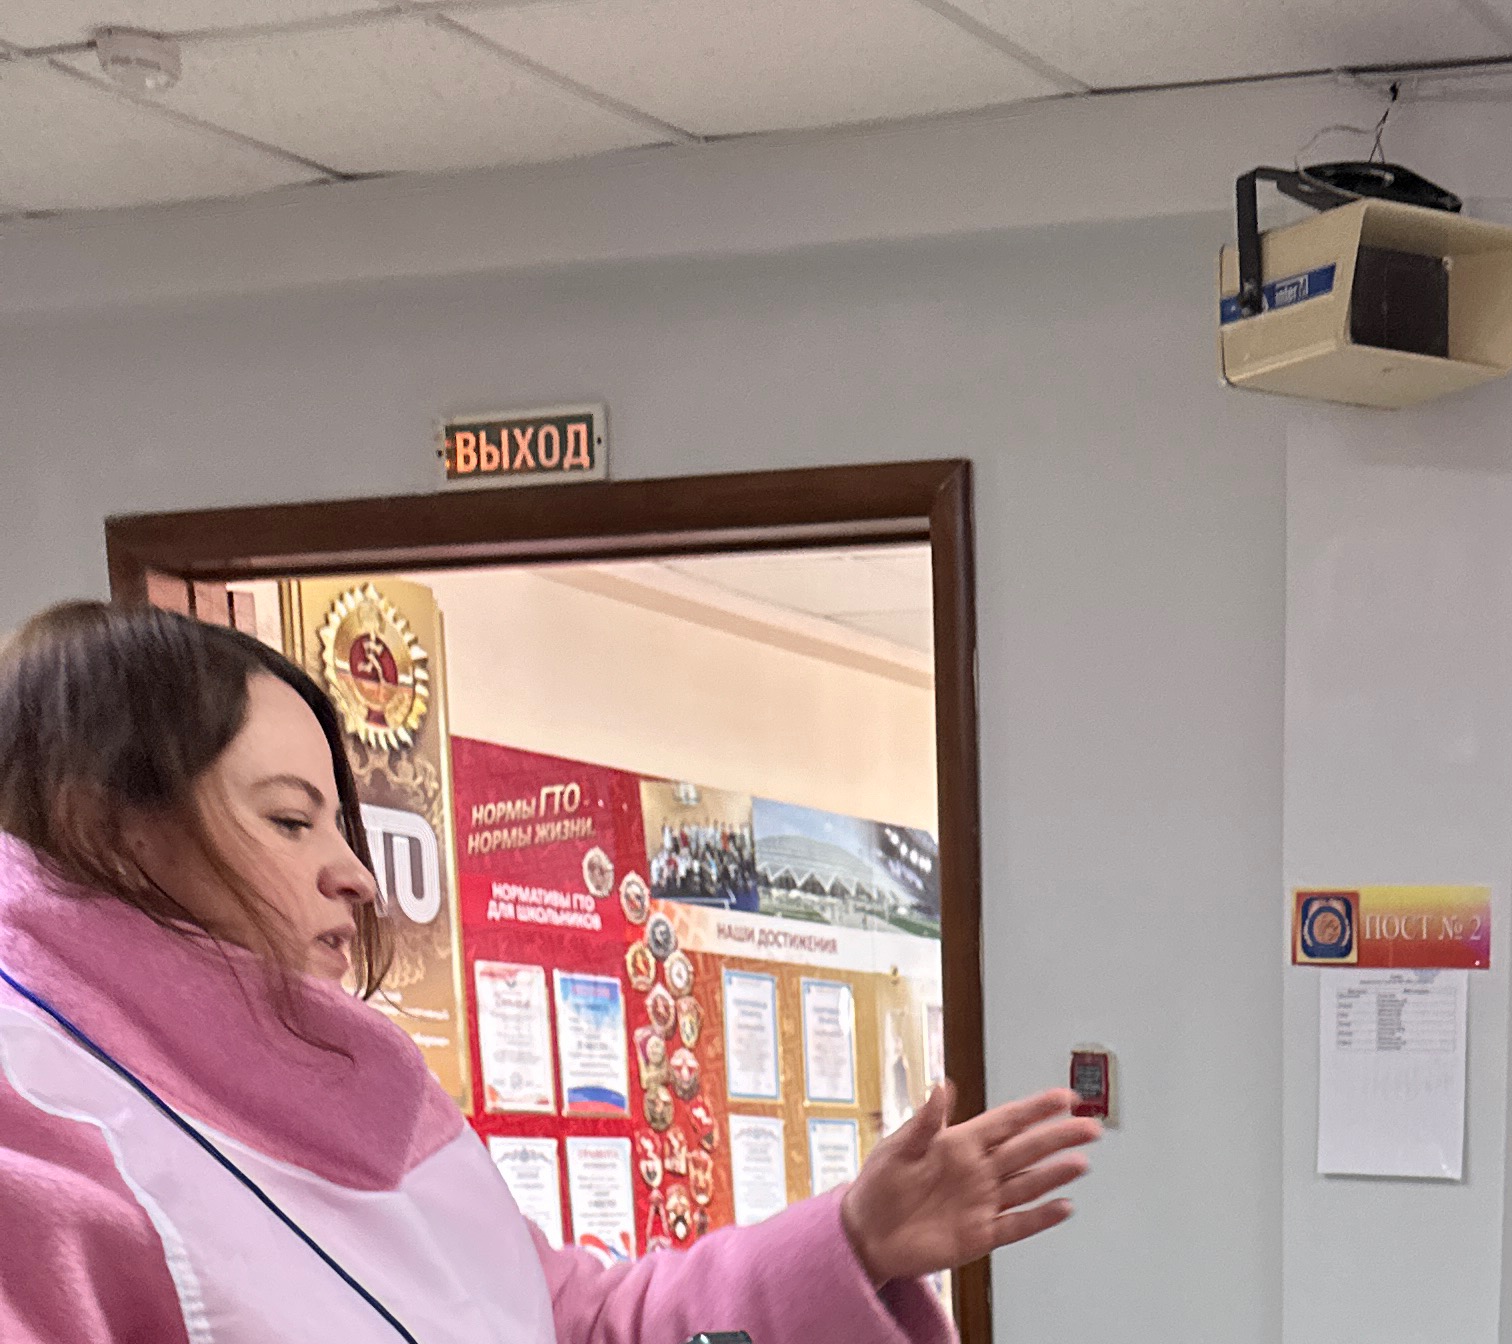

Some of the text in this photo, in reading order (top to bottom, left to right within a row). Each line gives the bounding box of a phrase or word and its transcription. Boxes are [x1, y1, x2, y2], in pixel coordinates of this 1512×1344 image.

[455, 422, 591, 474] ВЫХОД
[471, 782, 581, 827] НОРМЫ ГТО
[467, 824, 532, 855] НОРМЫ
[716, 923, 756, 943] НАШИ
[1365, 914, 1482, 940] ПОСТ № 2
